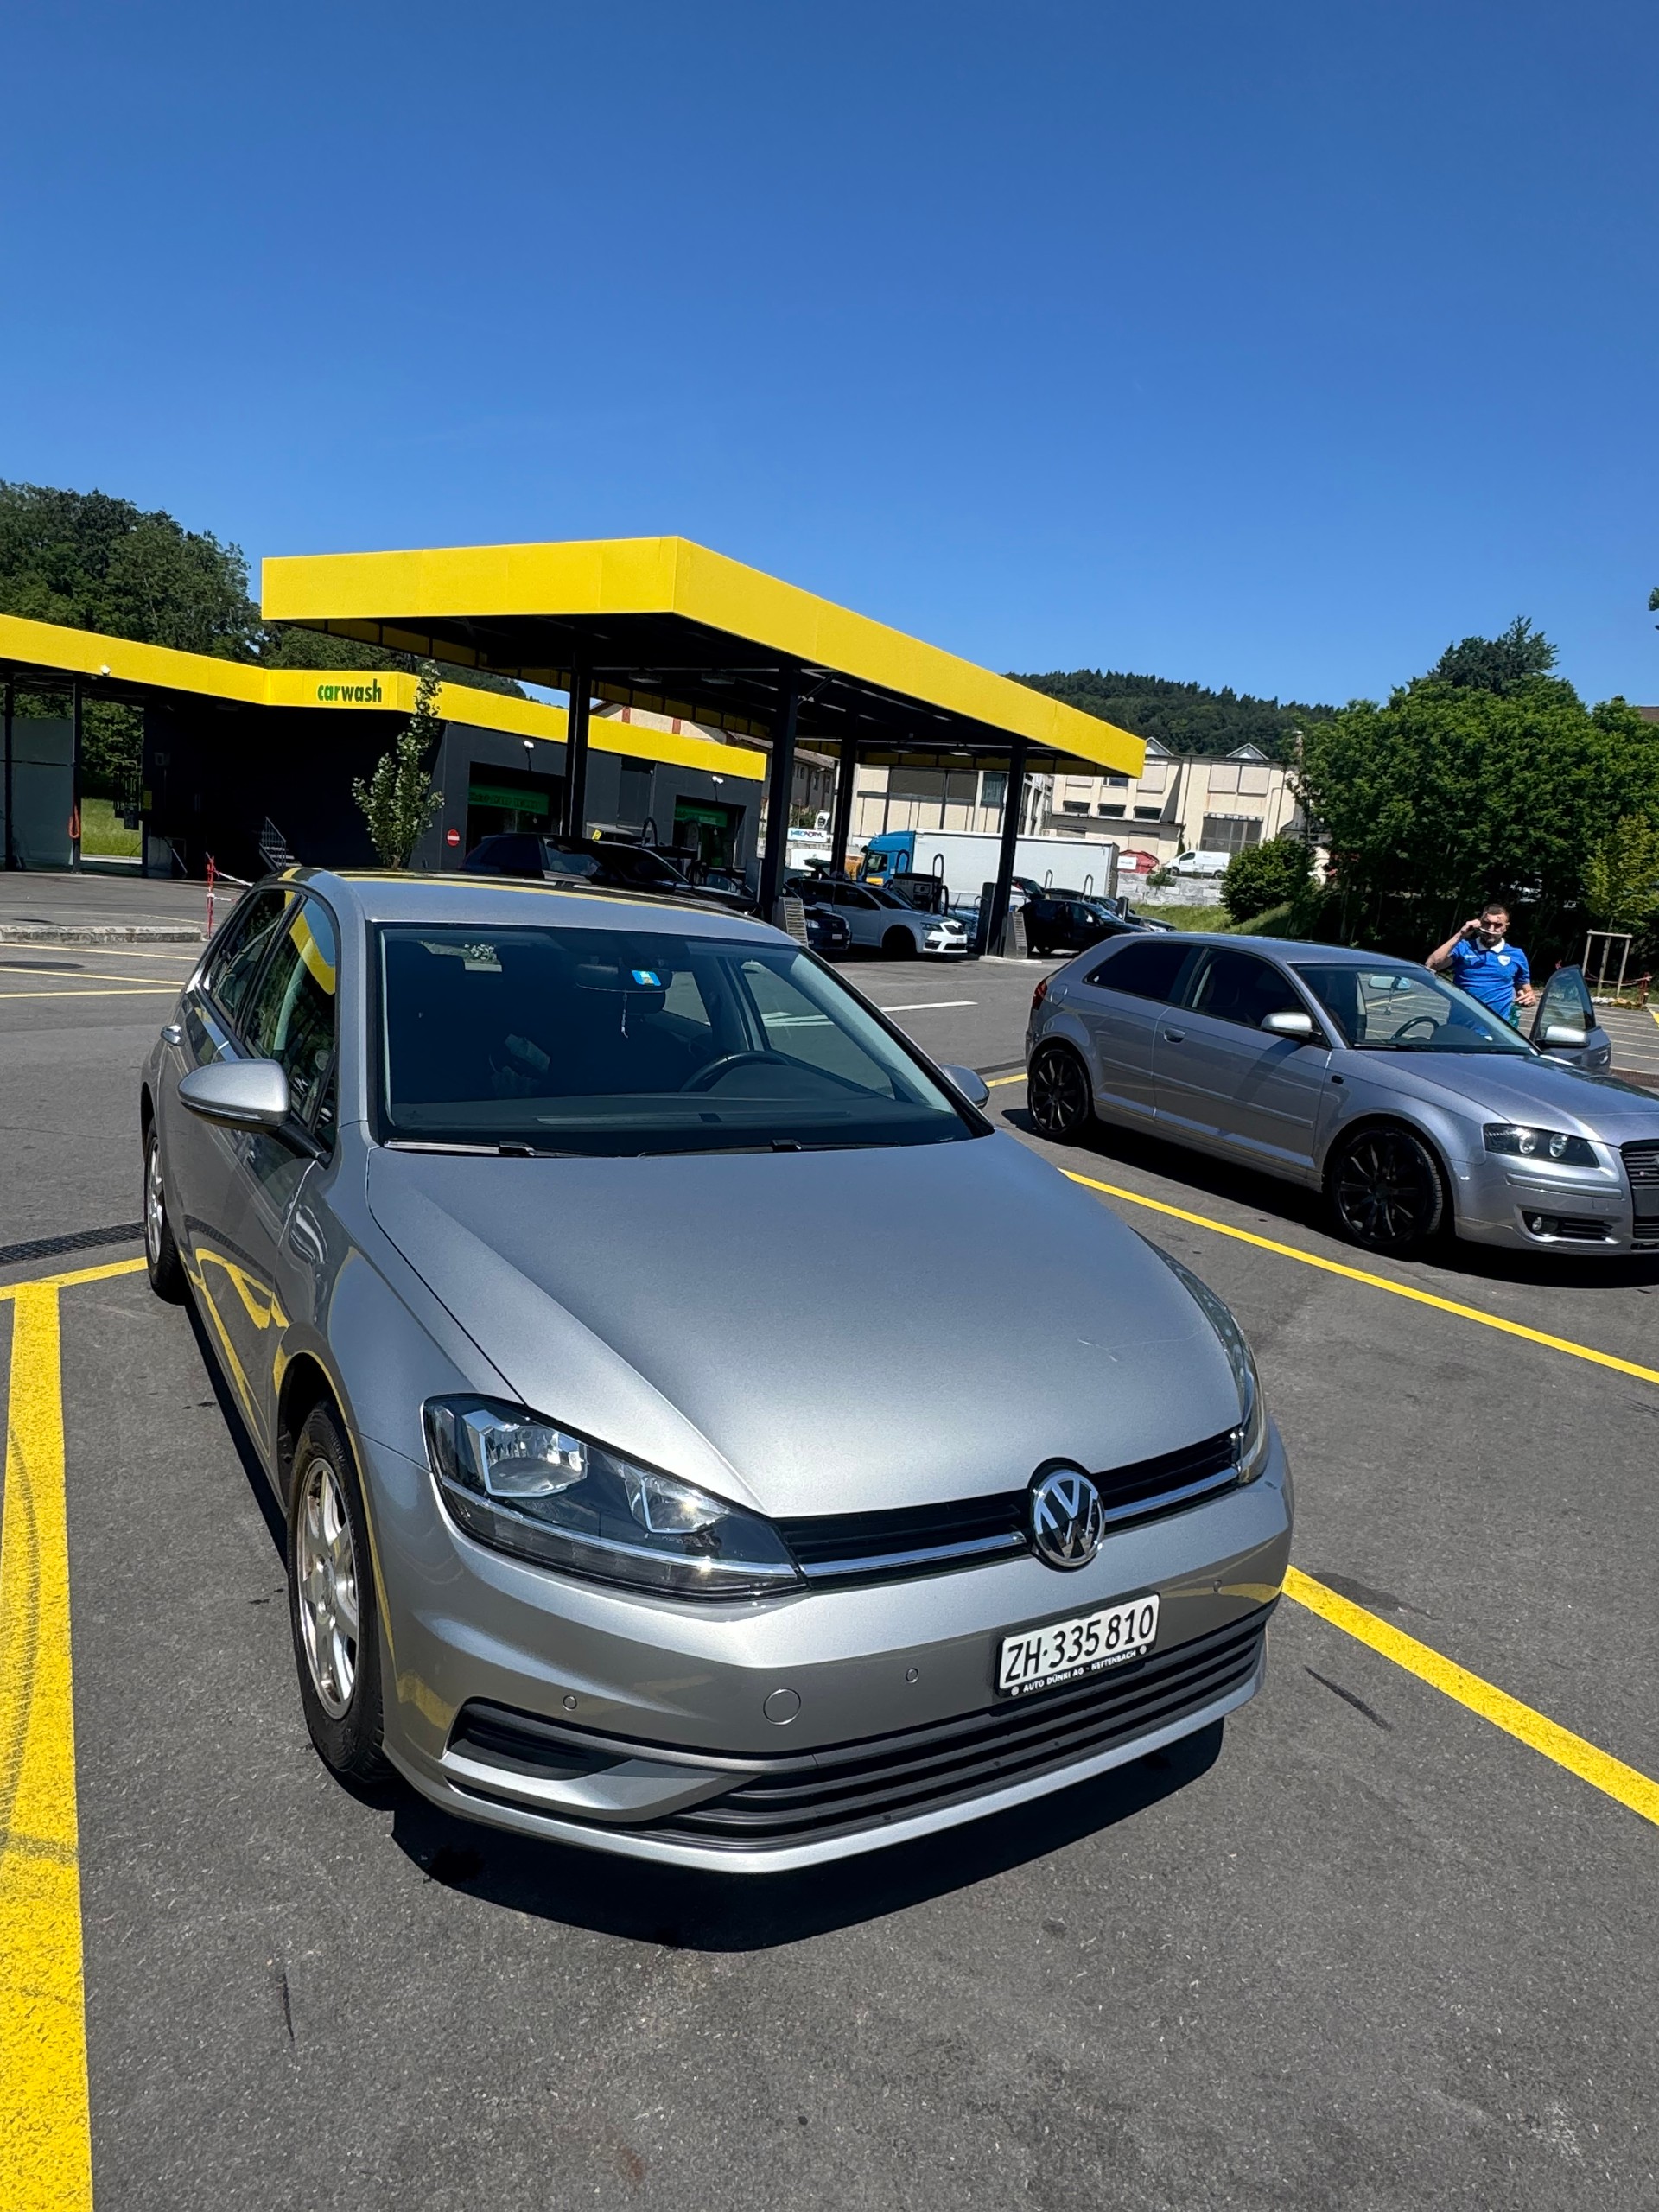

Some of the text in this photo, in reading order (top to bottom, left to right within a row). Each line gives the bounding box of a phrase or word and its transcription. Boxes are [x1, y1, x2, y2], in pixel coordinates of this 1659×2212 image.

[317, 678, 382, 702] carwash
[1022, 1680, 1045, 1693] AUTO
[1046, 1671, 1071, 1684] DÜNKI
[1072, 1667, 1084, 1677] AG
[1091, 1650, 1136, 1670] NEFTENBACH
